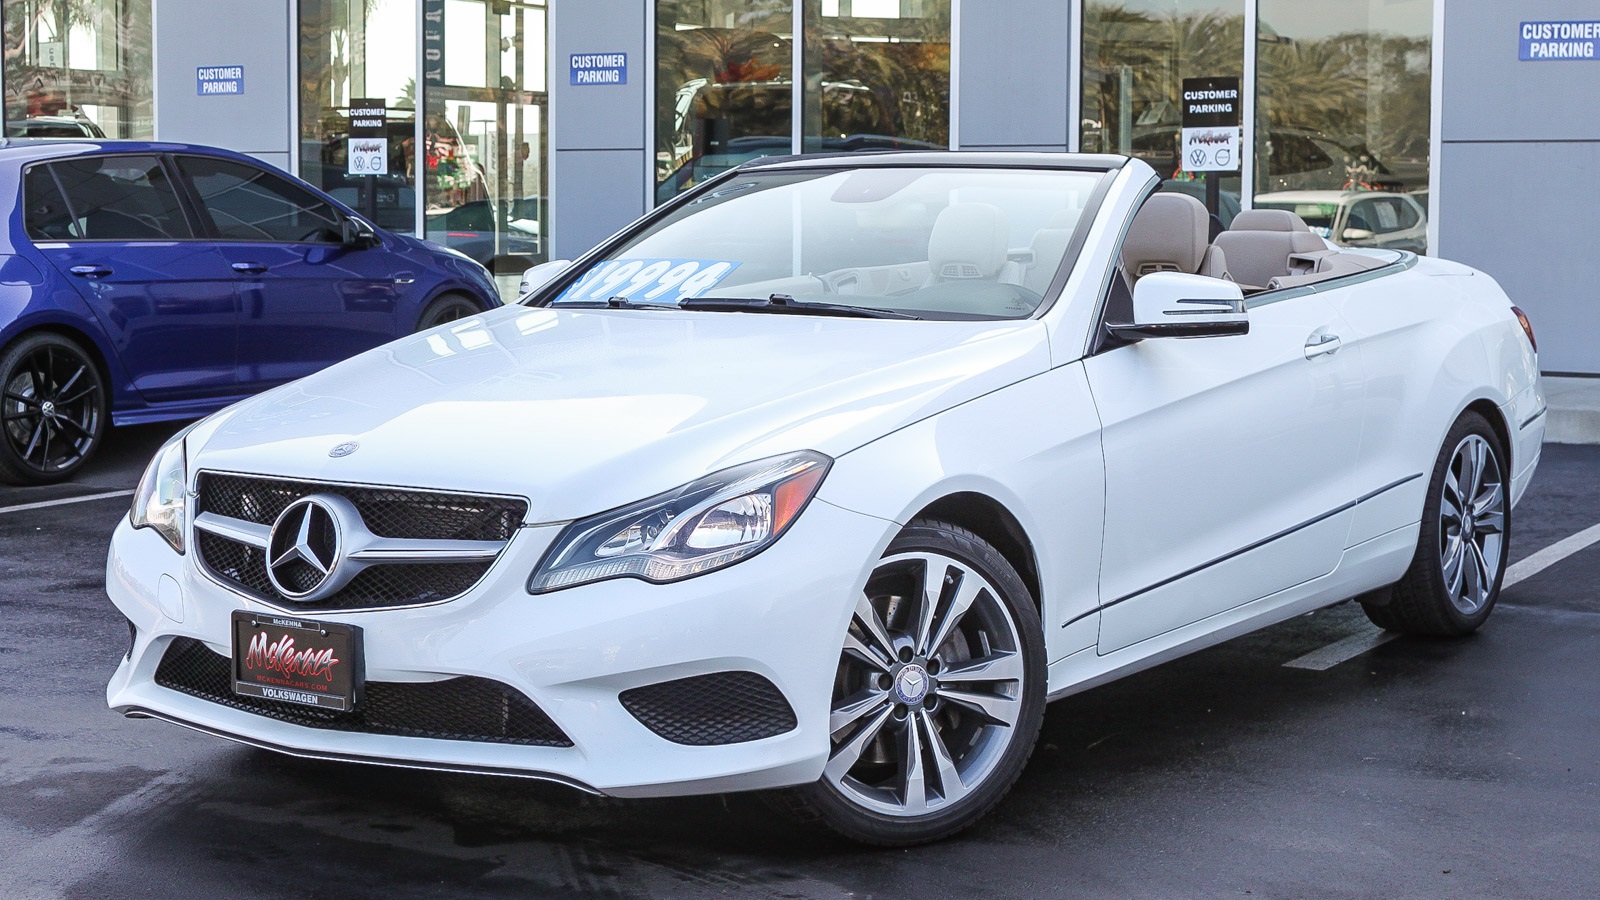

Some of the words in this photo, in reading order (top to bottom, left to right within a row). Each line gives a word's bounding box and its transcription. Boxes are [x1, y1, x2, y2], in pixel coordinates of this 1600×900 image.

[1522, 23, 1600, 40] CUSTOMER
[1530, 41, 1594, 58] PARKING
[571, 54, 625, 69] CUSTOMER
[198, 67, 242, 80] CUSTOMER
[577, 69, 620, 83] PARKING
[203, 81, 238, 93] PARKING
[1184, 89, 1238, 101] CUSTOMER
[349, 108, 386, 117] CUSTOMER
[1189, 103, 1233, 114] PARKING
[353, 119, 382, 128] PARKING
[273, 618, 302, 628] McKENNA
[262, 687, 319, 704] VOLKSWAGEN
